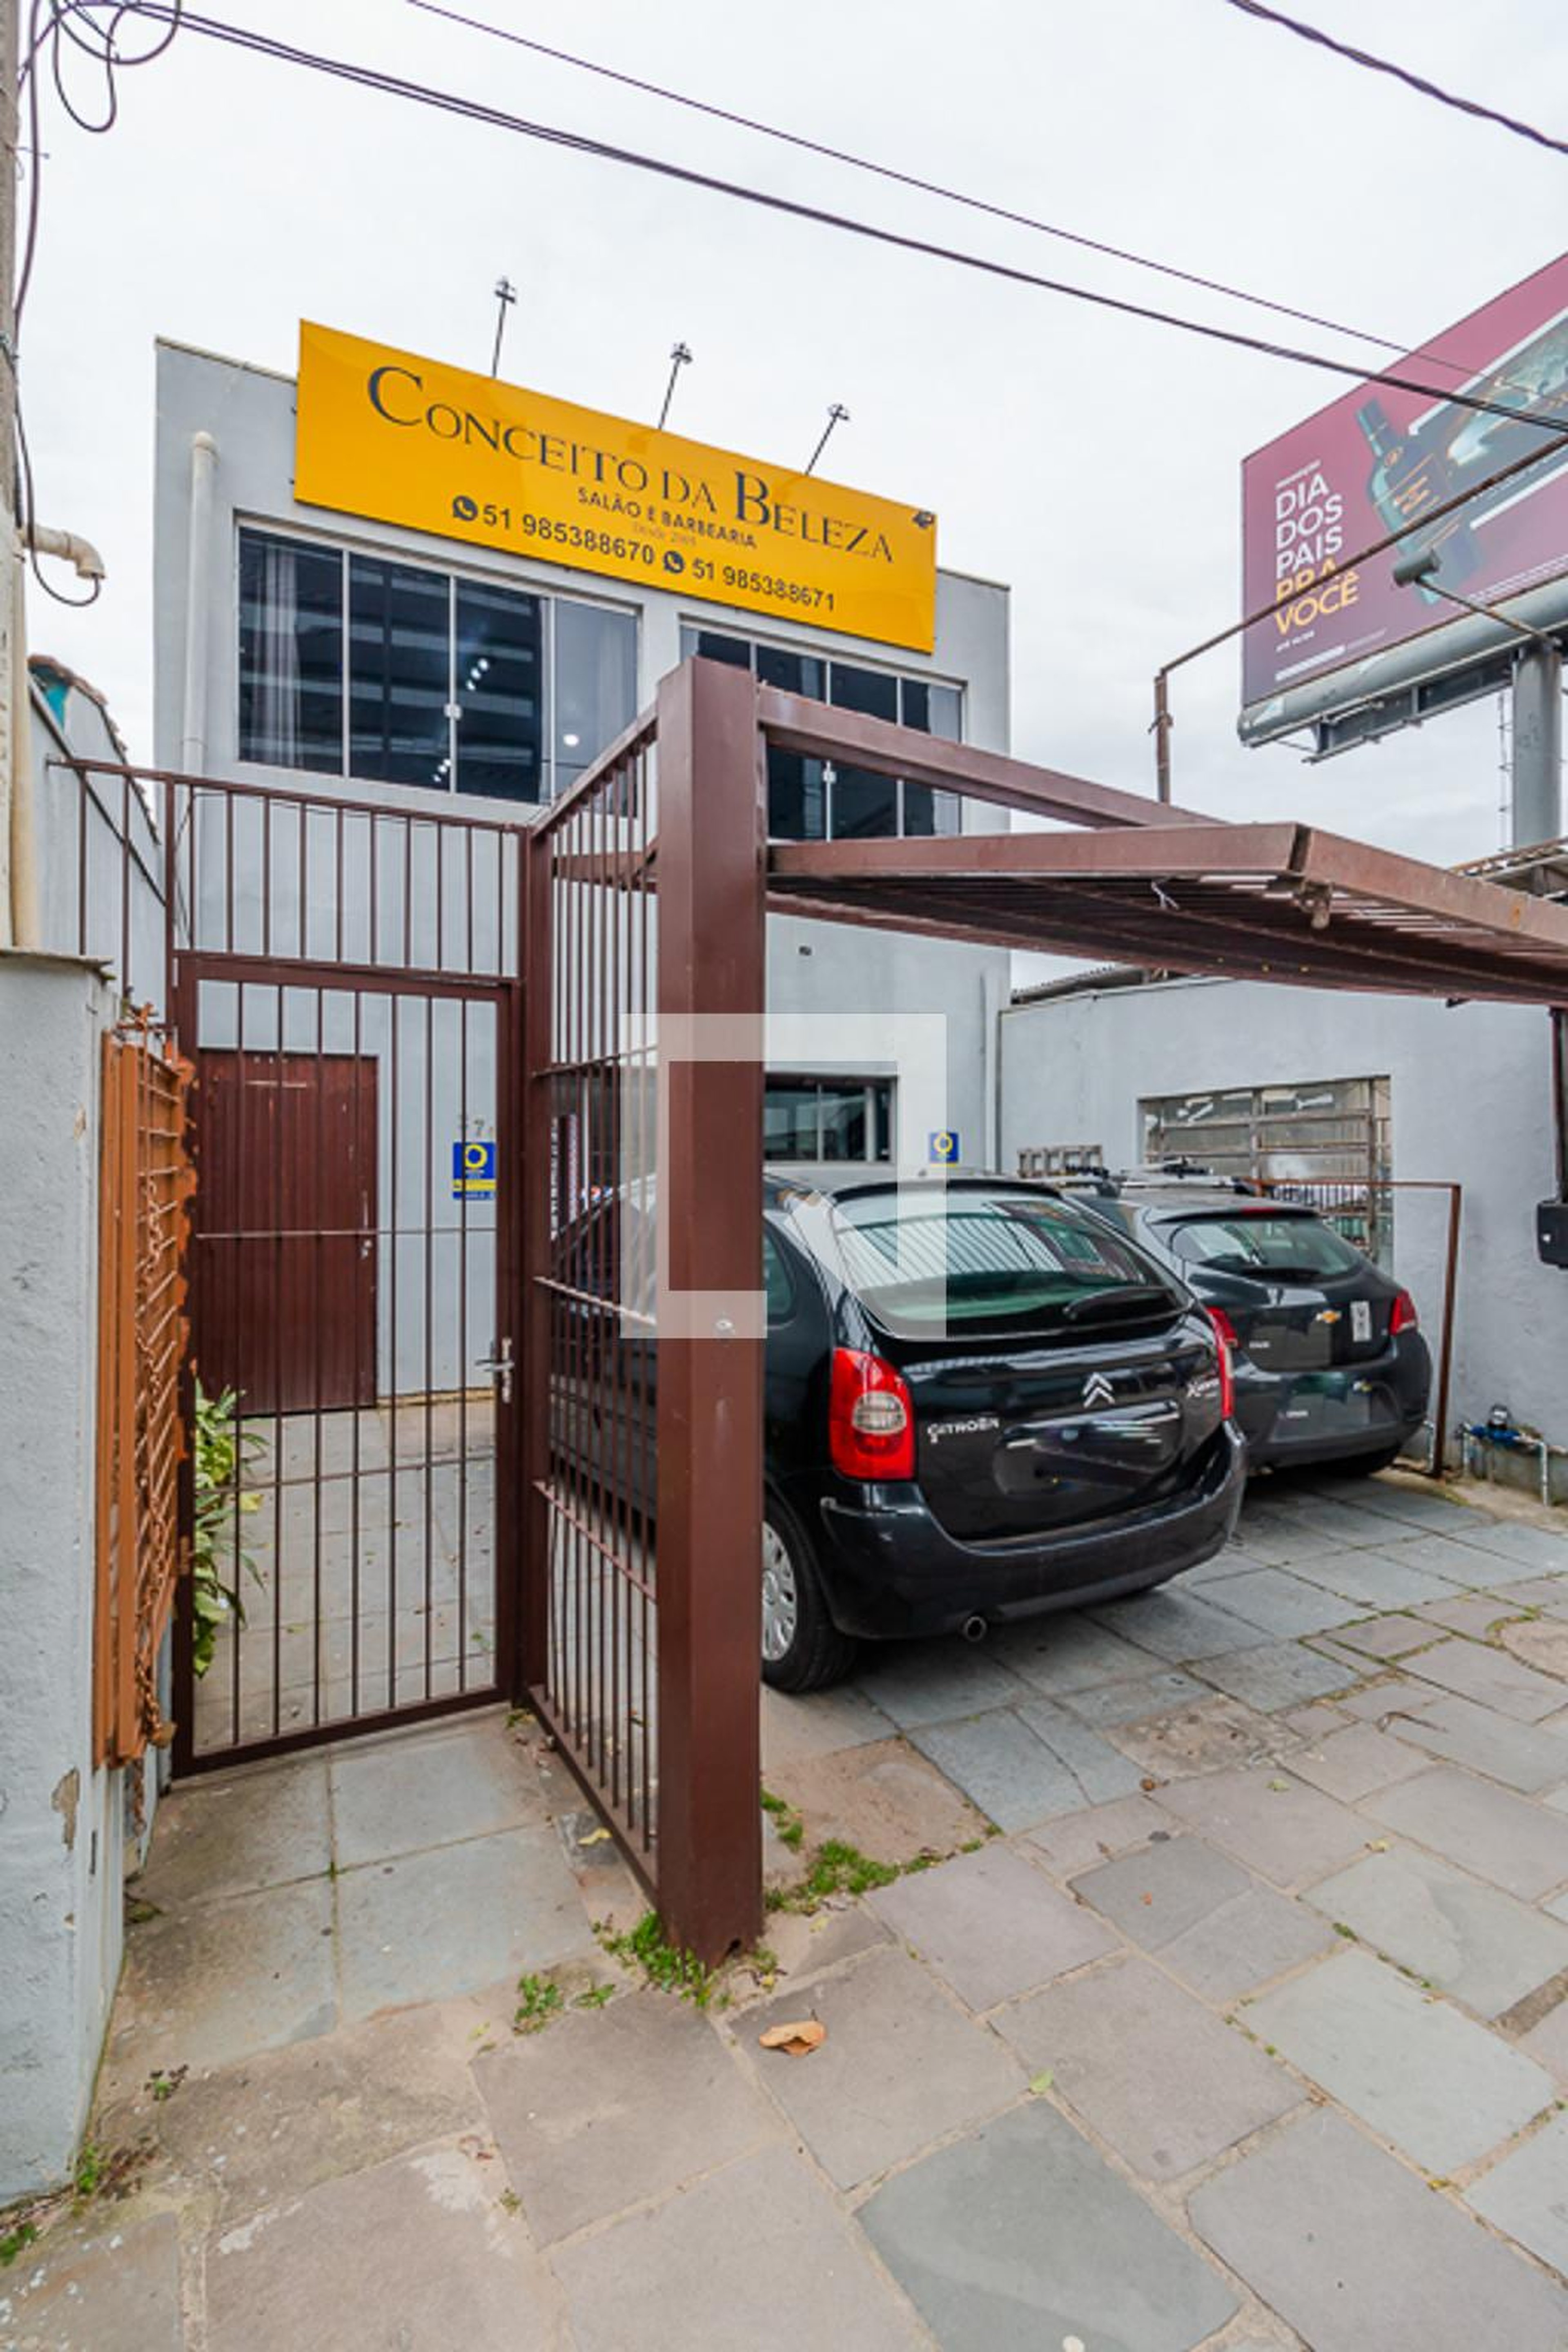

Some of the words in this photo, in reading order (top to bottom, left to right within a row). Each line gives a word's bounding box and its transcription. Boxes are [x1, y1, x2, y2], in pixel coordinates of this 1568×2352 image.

[368, 365, 648, 492] CONCEITO
[662, 470, 717, 514] DA
[735, 471, 894, 564] BELEZA
[577, 486, 641, 518] SALÃO
[647, 503, 655, 522] E
[662, 510, 757, 549] BARBEARIA
[1275, 474, 1329, 520] DIA
[1276, 493, 1343, 550] DOS
[483, 504, 511, 530] 51
[522, 514, 654, 565] 985388670
[692, 558, 714, 580] 51
[722, 566, 834, 611] 985388671
[1276, 526, 1343, 579] PAIS
[1274, 571, 1360, 635] VOCÊ
